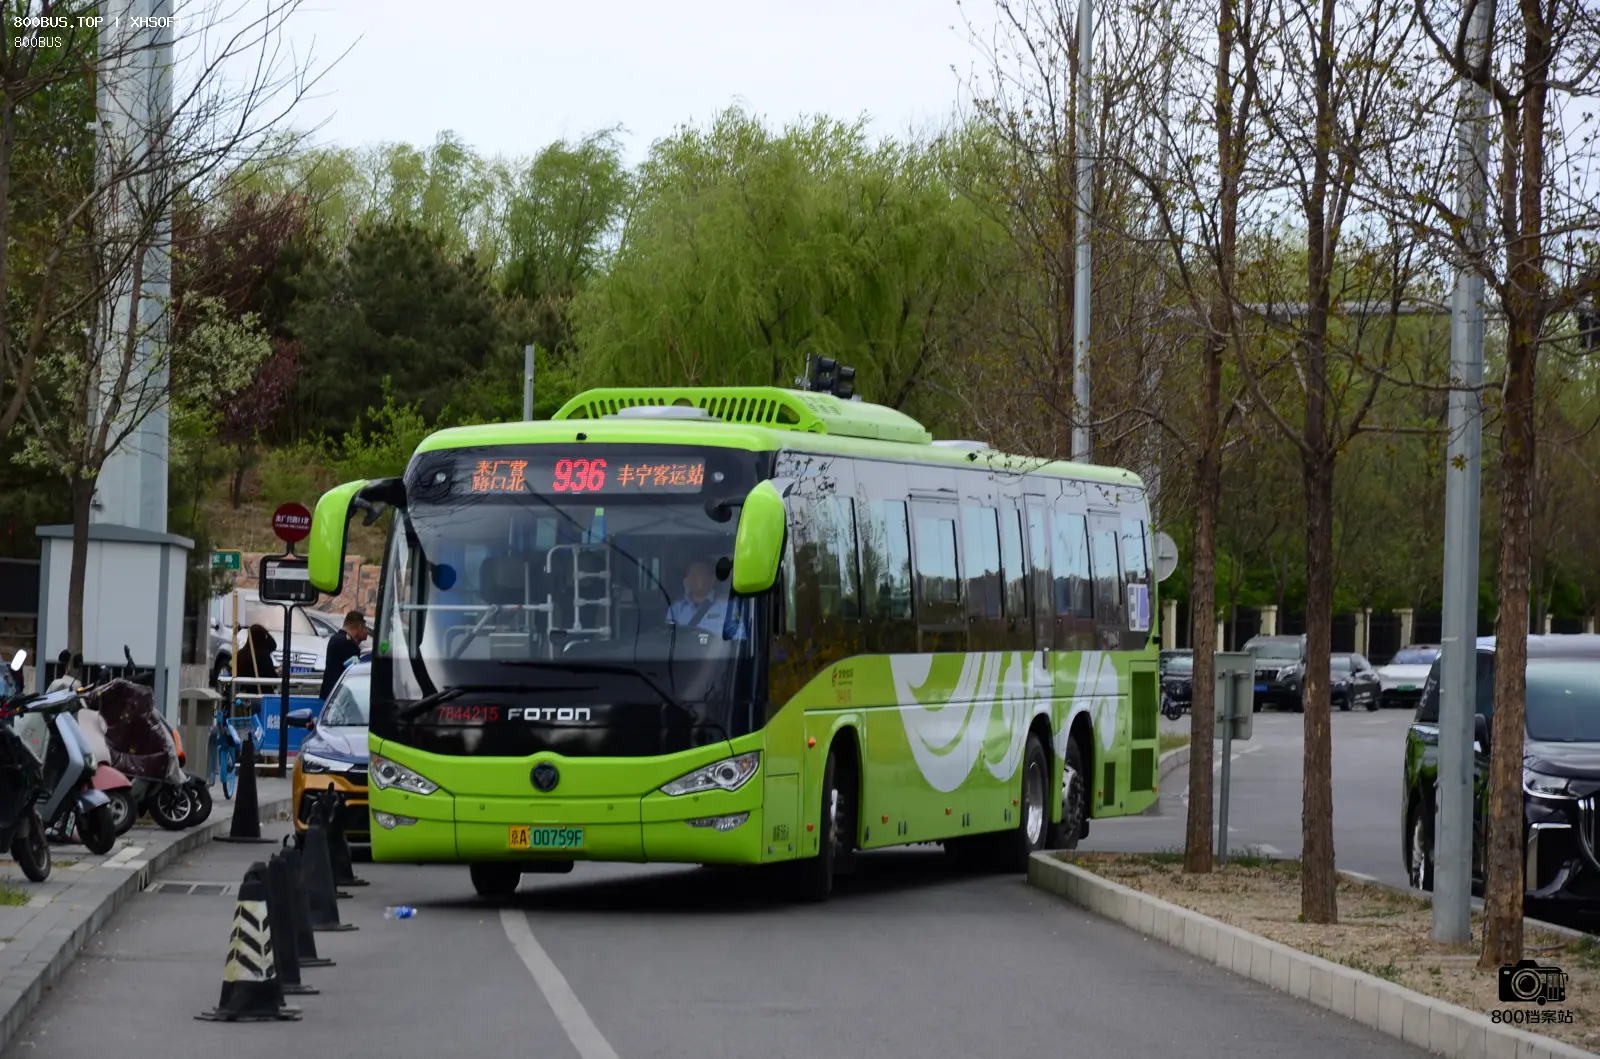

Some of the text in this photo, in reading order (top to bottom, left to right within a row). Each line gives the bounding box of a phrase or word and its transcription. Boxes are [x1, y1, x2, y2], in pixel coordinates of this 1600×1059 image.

[473, 460, 528, 477] 来广营
[552, 458, 608, 492] 936
[617, 463, 704, 487] 丰宁客运站
[471, 475, 528, 492] 路口北
[438, 705, 500, 722] 7844215
[507, 707, 591, 721] FOTON
[533, 828, 583, 846] 00759F
